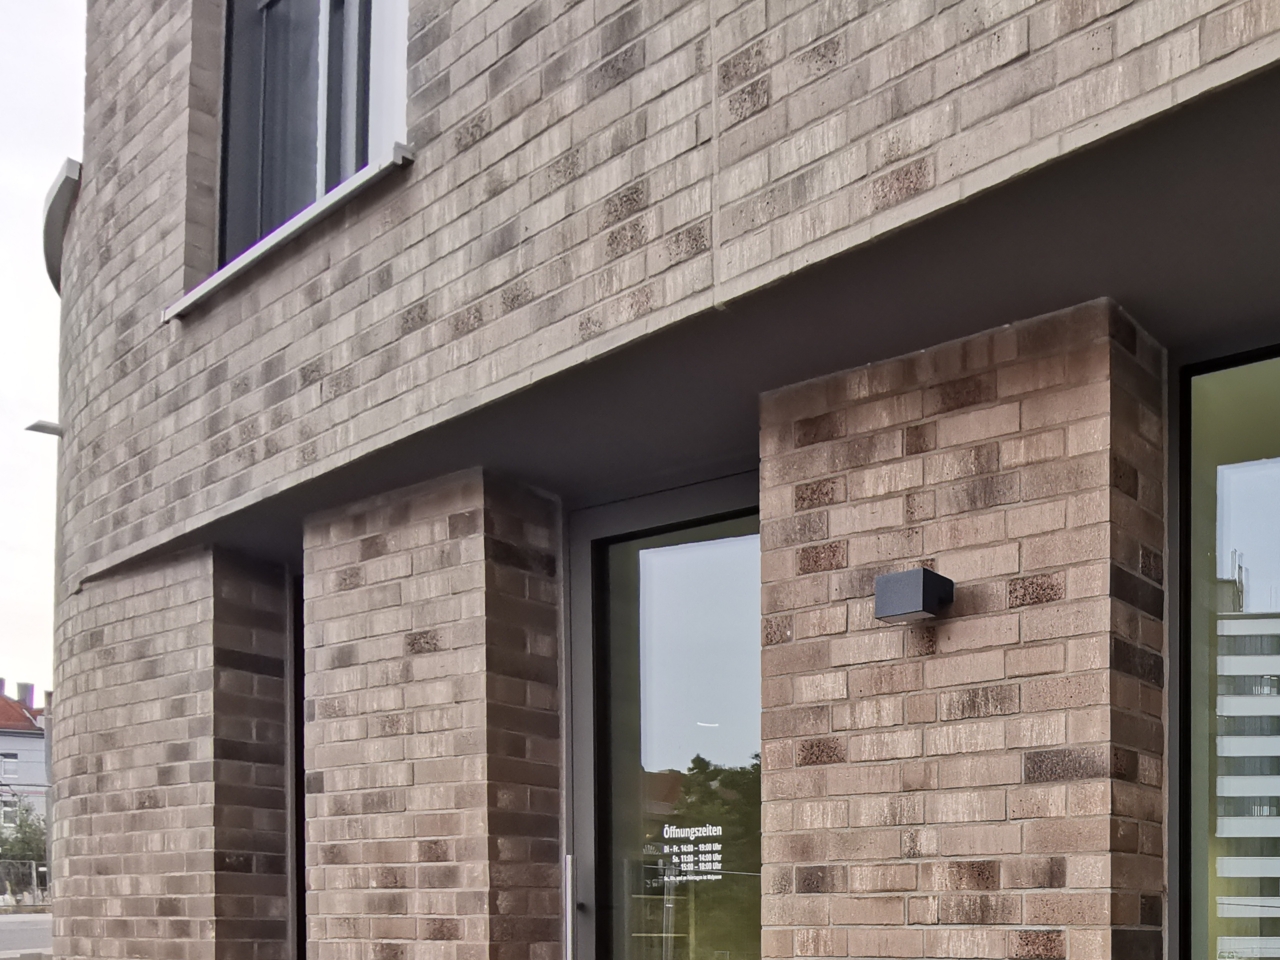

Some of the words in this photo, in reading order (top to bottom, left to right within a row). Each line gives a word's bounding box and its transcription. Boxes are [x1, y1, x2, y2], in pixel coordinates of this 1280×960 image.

[663, 824, 723, 840] Öffnungszeiten
[712, 843, 722, 851] Uhr
[712, 853, 722, 861] Uhr
[712, 862, 722, 870] Uhr
